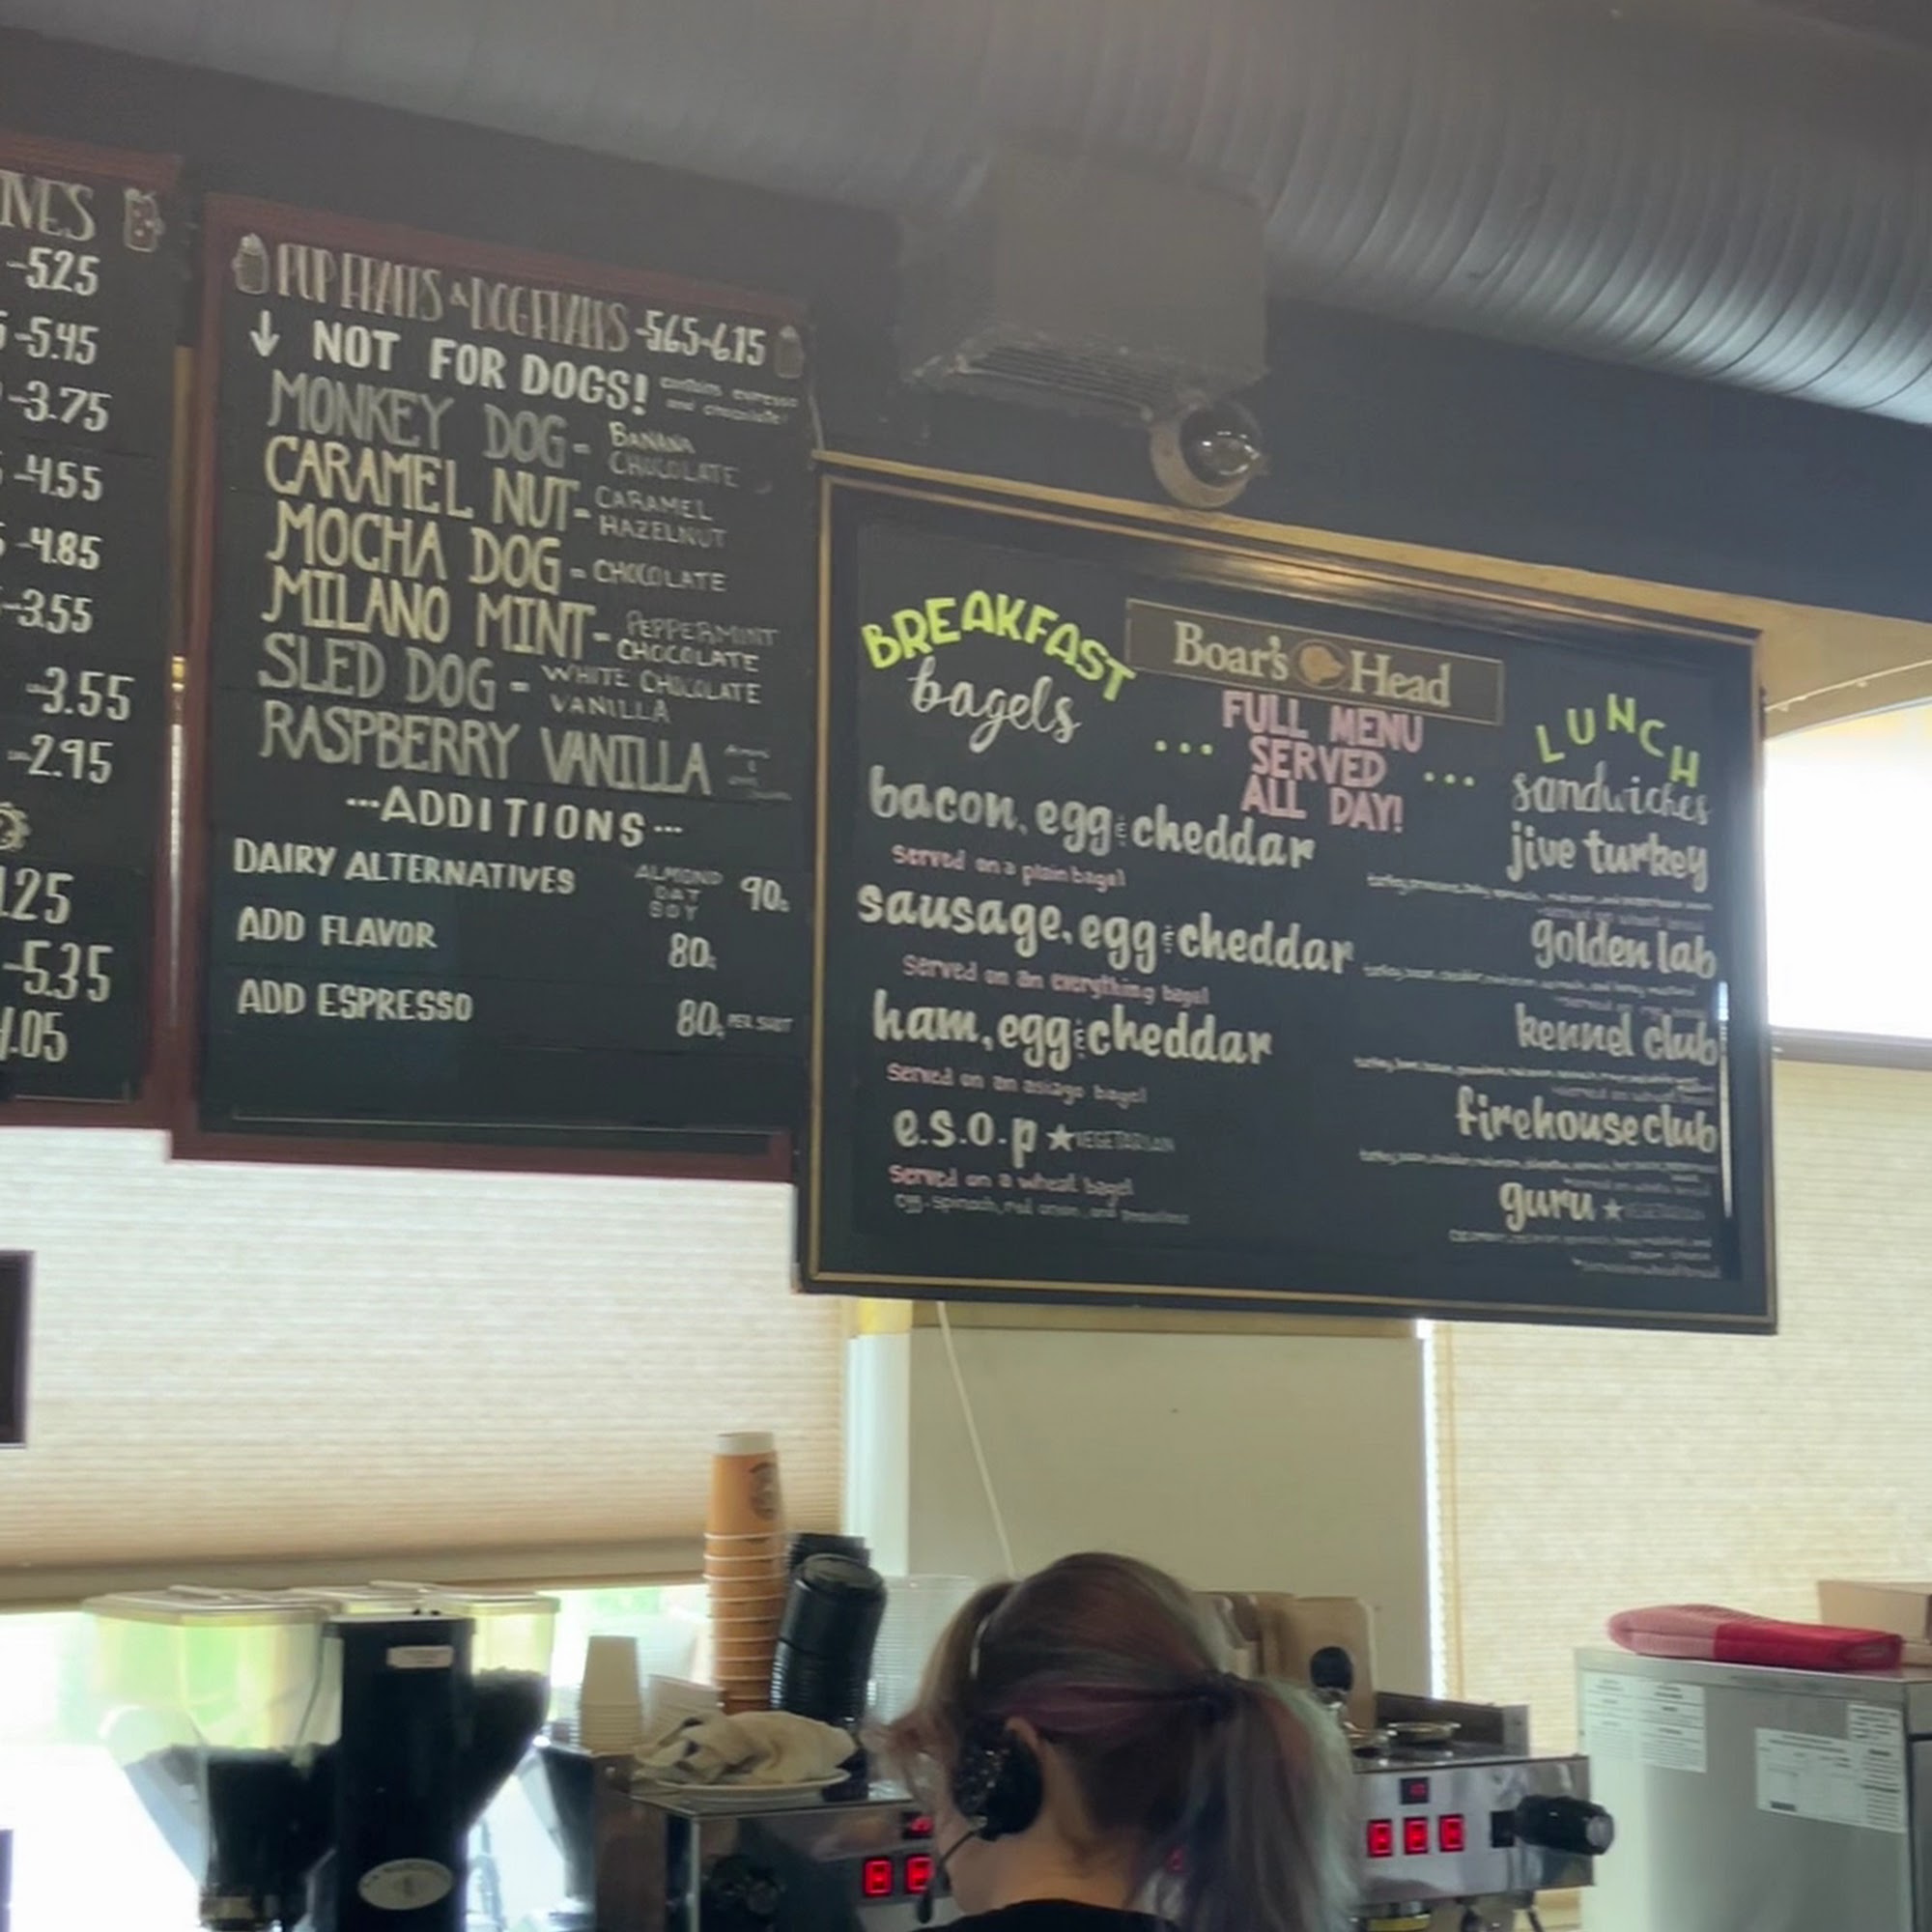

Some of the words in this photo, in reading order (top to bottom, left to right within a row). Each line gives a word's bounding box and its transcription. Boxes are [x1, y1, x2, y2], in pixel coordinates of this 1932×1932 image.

[313, 319, 401, 371] NOT
[430, 337, 506, 389] FOR
[520, 353, 649, 415] DOGS!
[267, 368, 454, 450] MONKEY
[609, 420, 696, 454] BANANA
[264, 435, 474, 519] CARAMEL
[594, 486, 713, 521] CARAMEL
[609, 450, 739, 488] CHOCOLATE
[266, 499, 448, 580] MOCHA
[593, 558, 726, 592] CHOCOLATE
[599, 514, 727, 548] HAZELNUT
[261, 564, 450, 643] MILANO
[627, 610, 779, 646] PEPPERMINT
[257, 632, 384, 698] SLED
[541, 664, 630, 688] WHITE
[639, 669, 761, 704] CHOCOLATE
[616, 638, 759, 672] CHOCOLATE
[862, 589, 1136, 701] BREAKFAST
[1173, 619, 1289, 681] Boar's
[1349, 649, 1451, 708] Head
[549, 694, 670, 724] VANILLA
[907, 656, 1082, 753] bagels
[1222, 689, 1309, 740] FULL
[1329, 704, 1425, 753] MENU
[259, 699, 521, 780] RASPBERRY
[540, 726, 712, 795] VANILLA
[1249, 734, 1387, 789] SERVED
[1535, 693, 1701, 788] LUNCH
[869, 764, 1028, 837] bacon,
[1036, 800, 1112, 858] egg
[1131, 803, 1316, 868] cheddar
[1240, 773, 1307, 820] ALL
[1329, 786, 1405, 834] DAY!
[1511, 759, 1712, 825] sandwiches
[233, 837, 338, 877] DAIRY
[344, 850, 576, 895] ALTERNATIVES
[1506, 820, 1577, 883] jive
[1582, 829, 1709, 893] turkey
[648, 900, 699, 921] SOY
[655, 885, 702, 901] OAT
[236, 905, 306, 942] ADD
[320, 914, 438, 949] FLAVOR
[1079, 914, 1157, 974] egg
[1177, 910, 1354, 975] cheddar
[1530, 918, 1652, 970] golden
[1657, 930, 1719, 980] lab
[238, 979, 306, 1015] ADD
[318, 981, 473, 1021] ESPRESSO
[997, 1013, 1072, 1071] egg
[1088, 1004, 1273, 1065] cheddar
[1514, 1001, 1634, 1058] kennel
[1644, 1010, 1719, 1066] club
[1456, 1084, 1640, 1147] firehouse
[1642, 1103, 1719, 1153] club
[1498, 1180, 1597, 1233] guru
